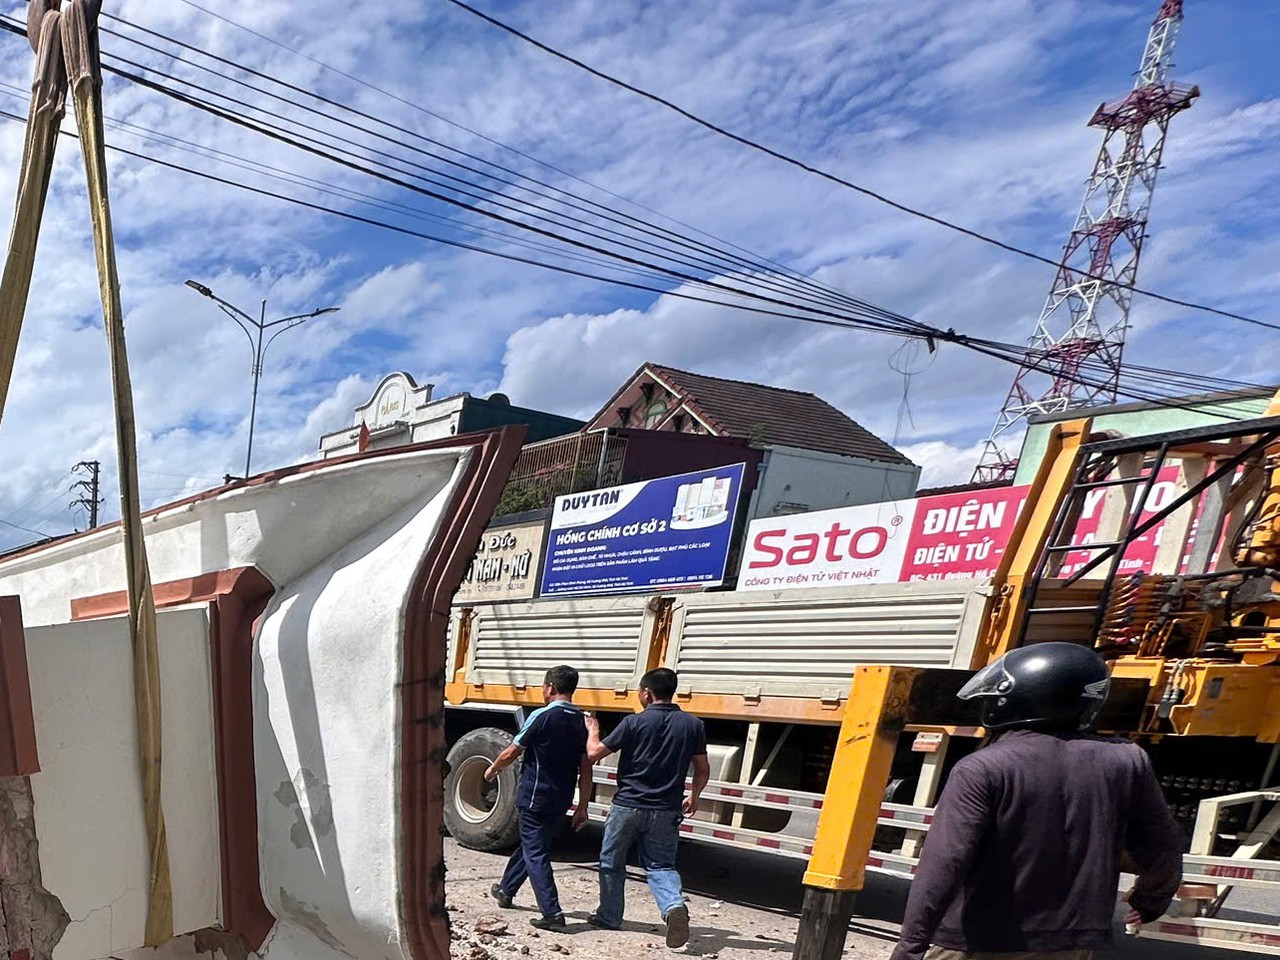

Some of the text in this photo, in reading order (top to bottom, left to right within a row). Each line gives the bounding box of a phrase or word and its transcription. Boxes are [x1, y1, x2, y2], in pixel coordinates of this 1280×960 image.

[658, 520, 667, 532] 2
[922, 499, 1008, 538] ĐIỆN
[748, 522, 888, 569] Sato
[912, 542, 961, 567] ĐIỆN
[965, 536, 995, 562] TỬ
[744, 567, 880, 587] CÔNG TY ĐIỆN TỬ VIỆT NHẬT
